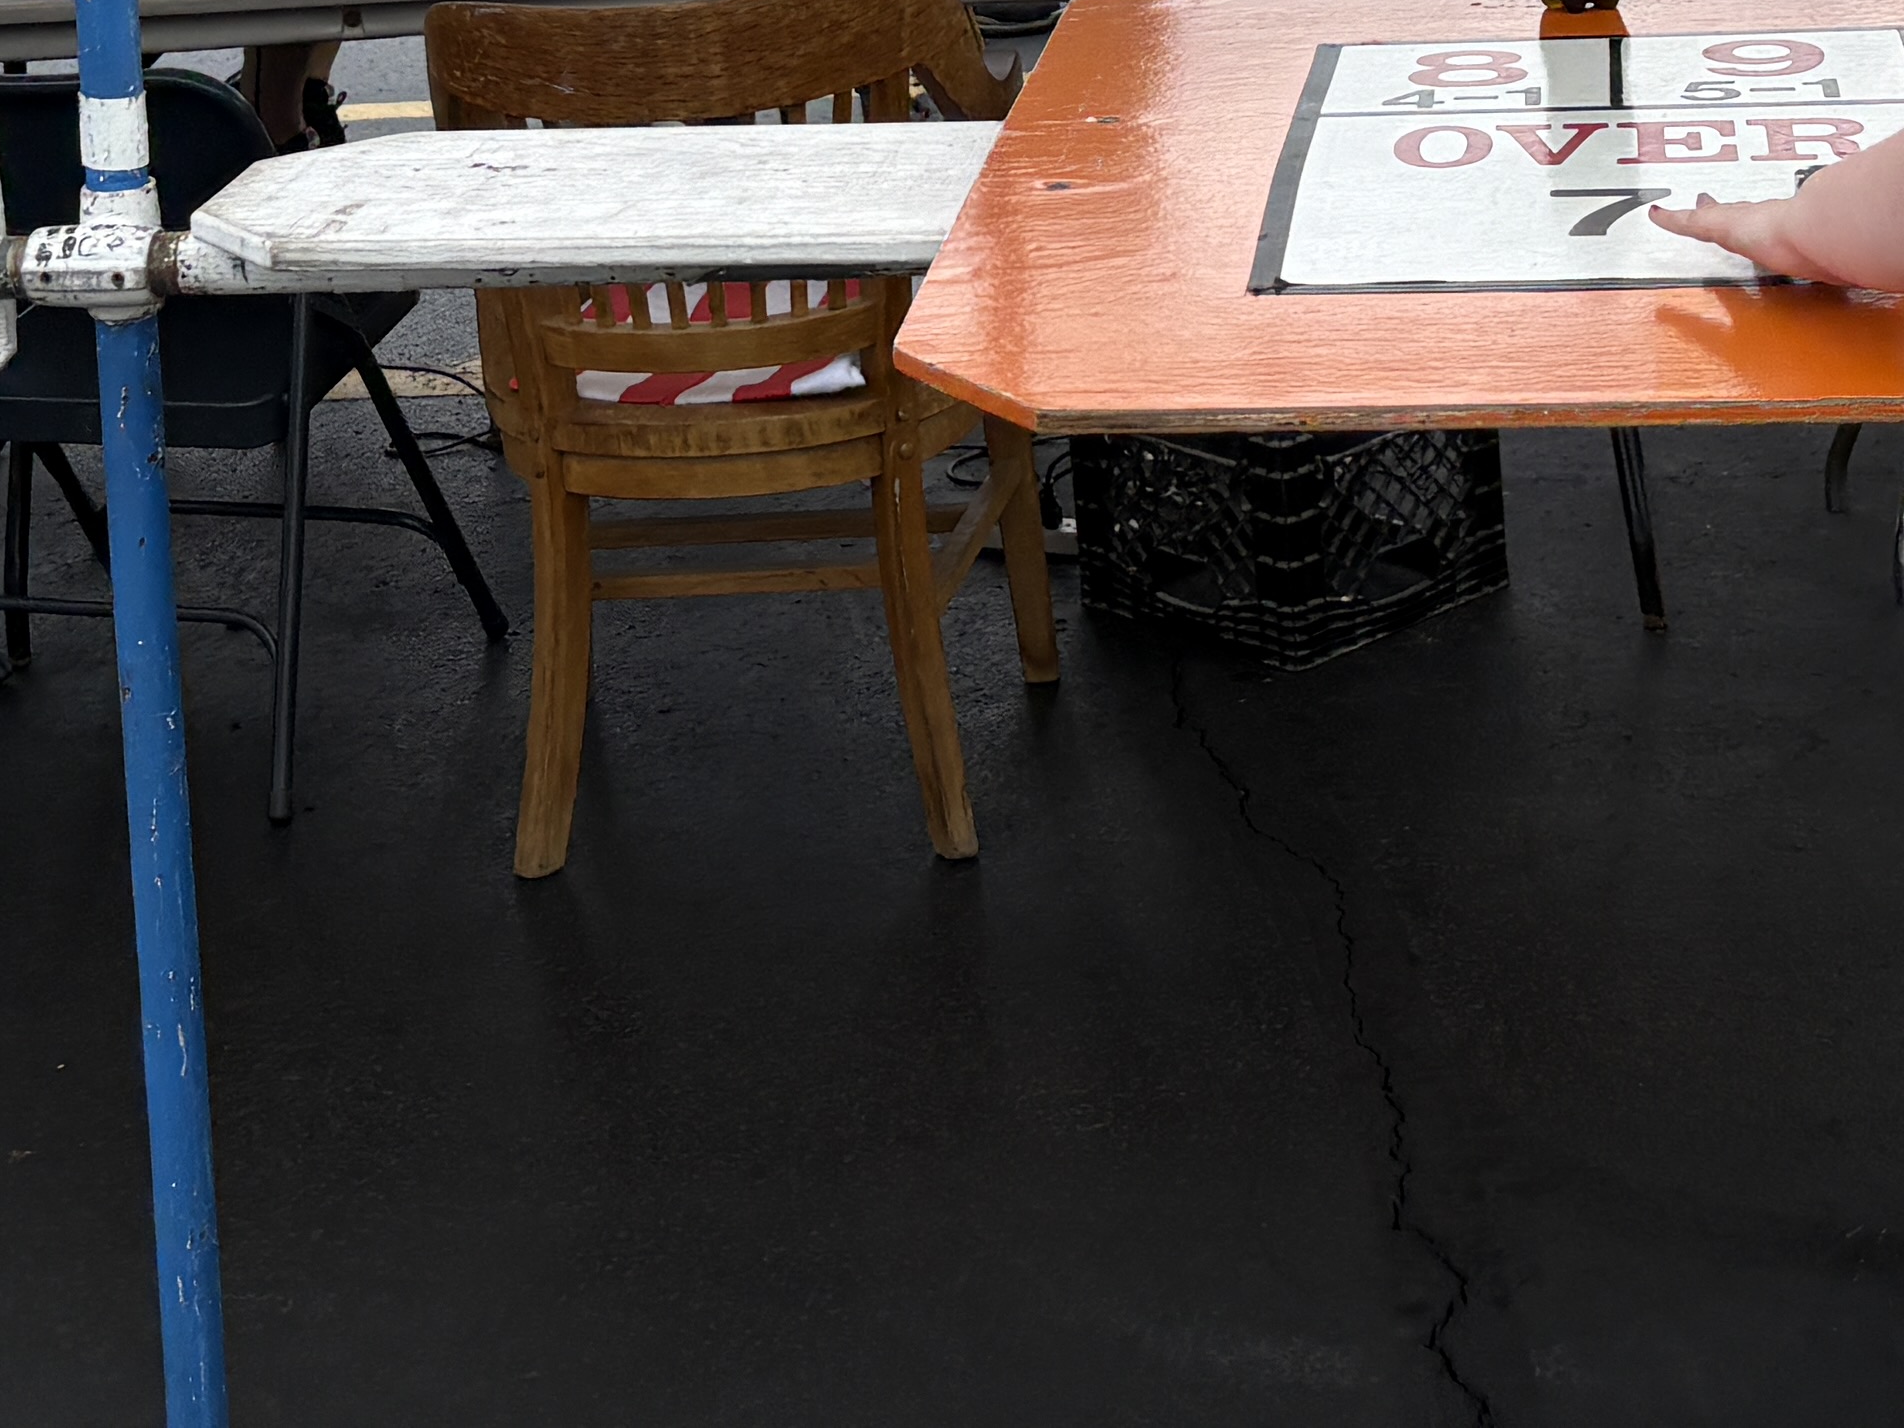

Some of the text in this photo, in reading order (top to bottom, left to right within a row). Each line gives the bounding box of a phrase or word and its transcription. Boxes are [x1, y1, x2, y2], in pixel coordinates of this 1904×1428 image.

[1407, 50, 1529, 88] 8
[1702, 39, 1826, 77] 9
[1382, 77, 1841, 110] 4-1 5-1
[1393, 116, 1867, 169] OVER
[1549, 188, 1672, 237] 7
